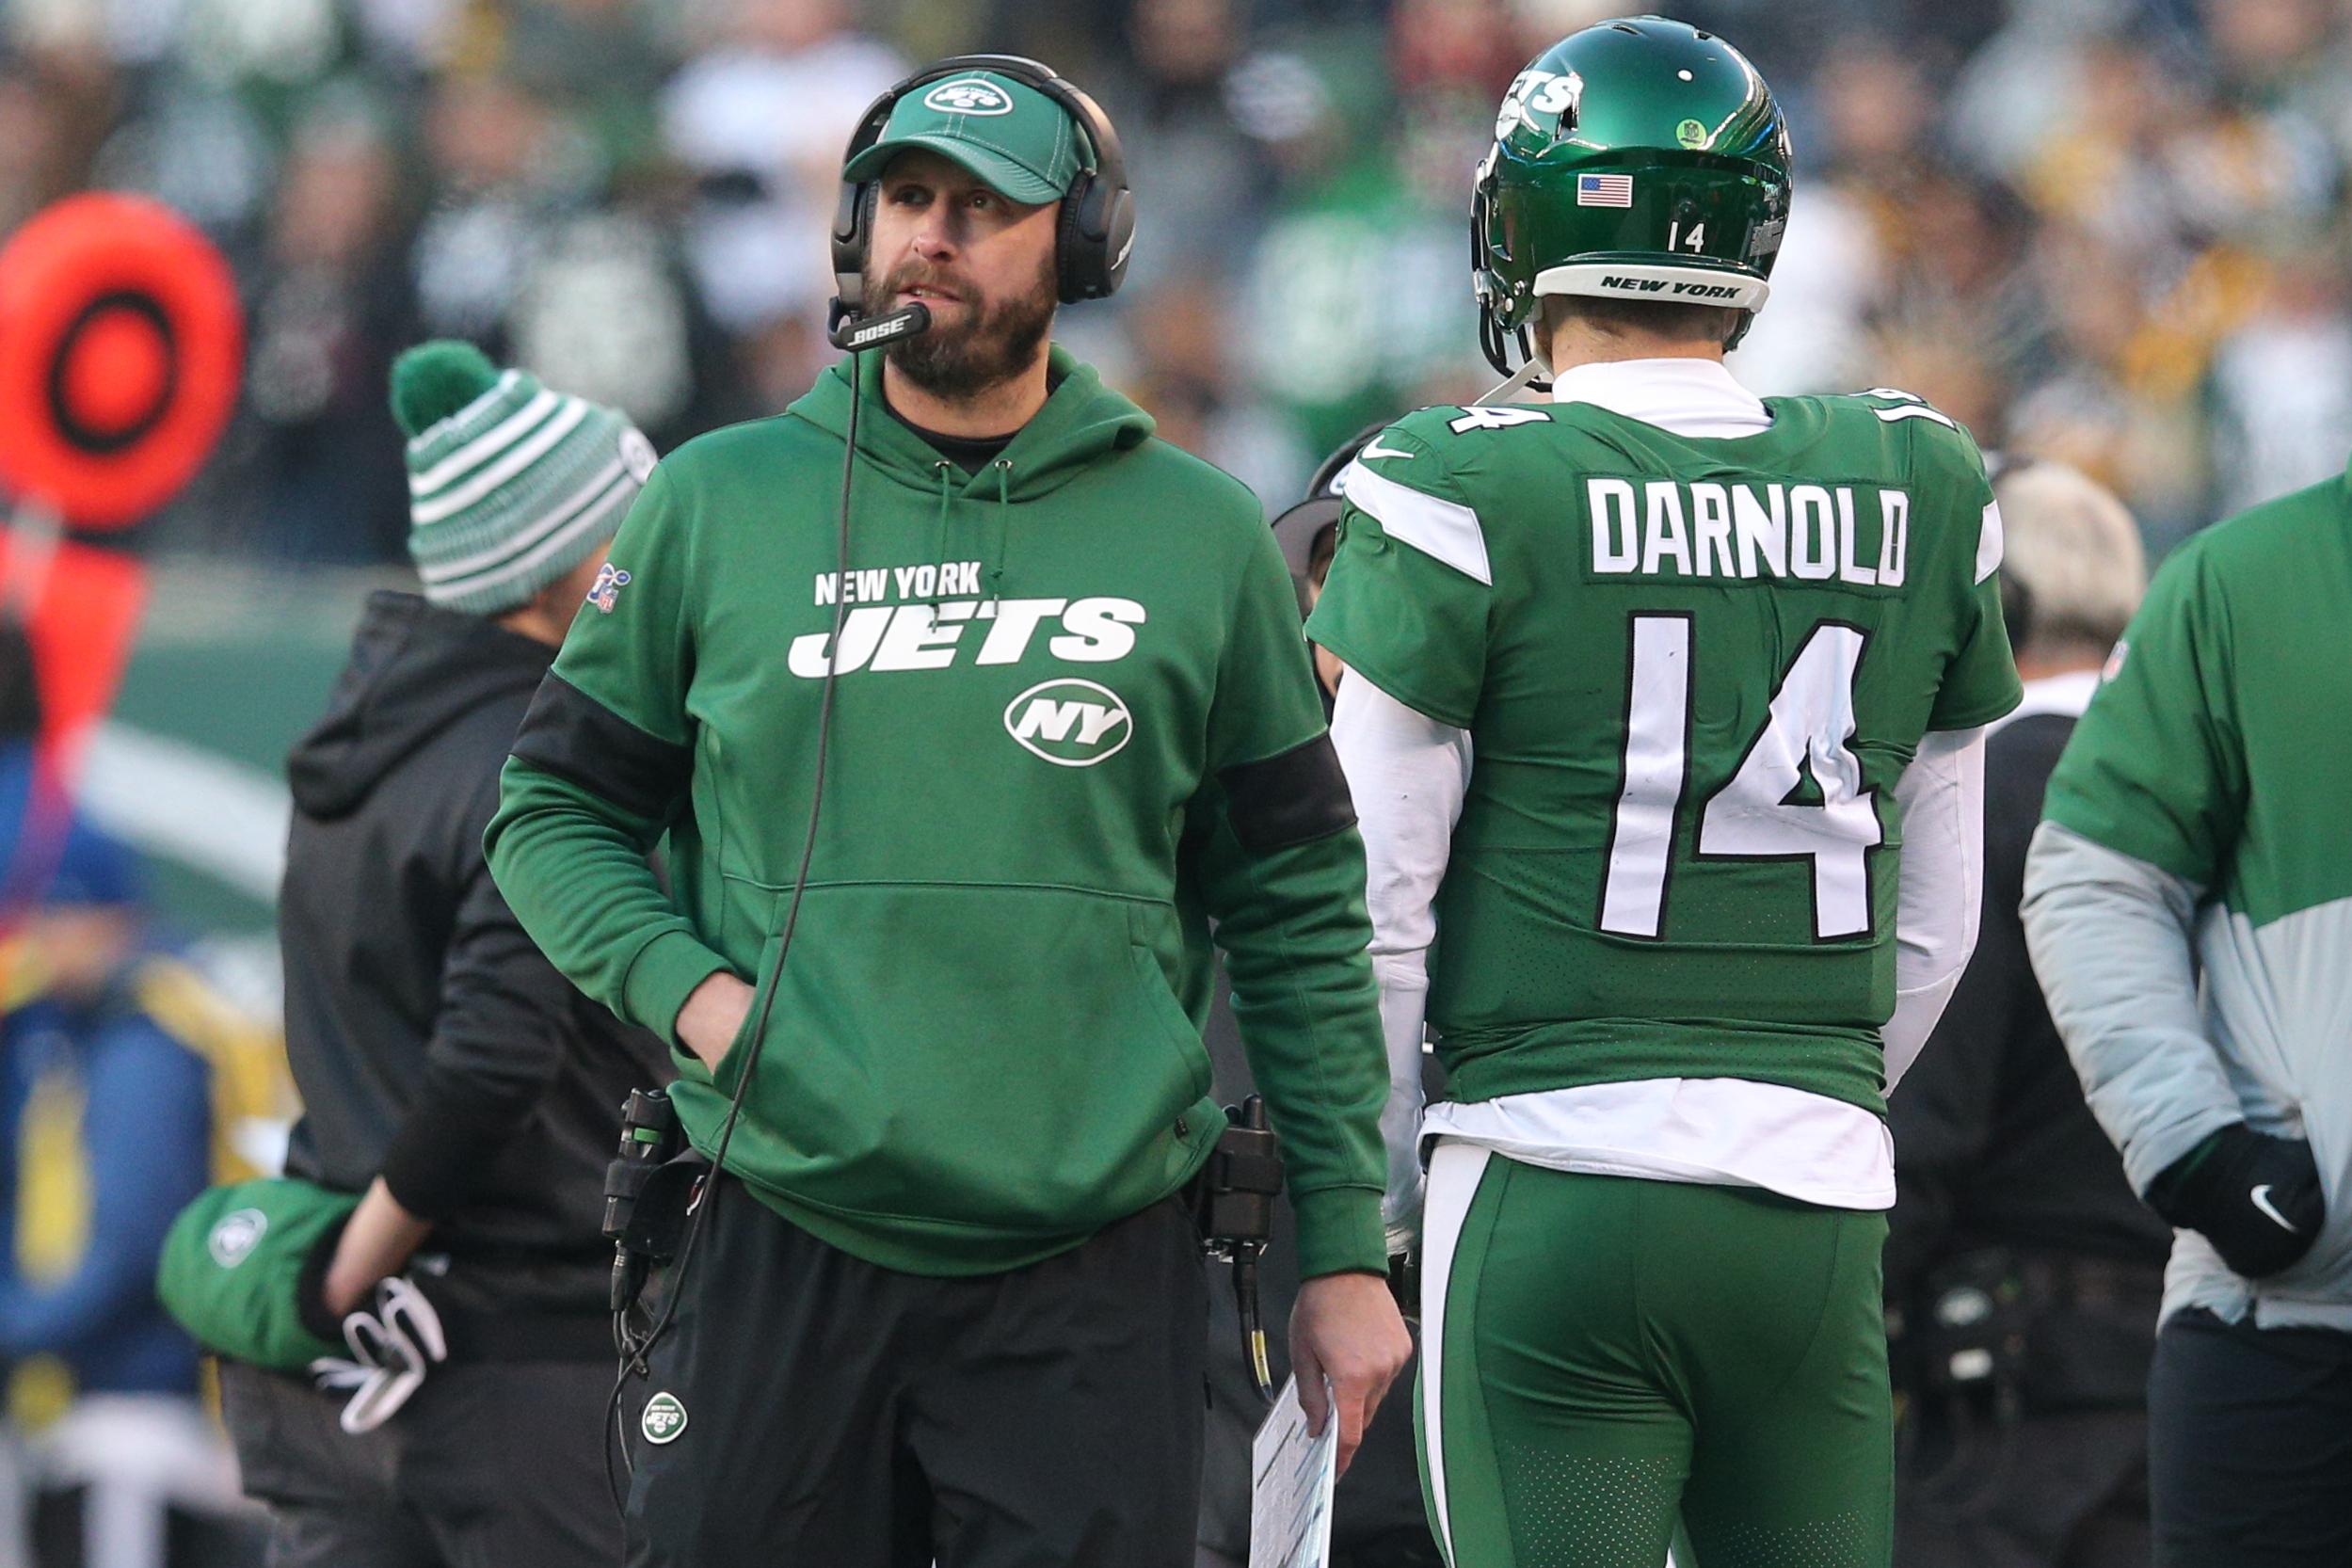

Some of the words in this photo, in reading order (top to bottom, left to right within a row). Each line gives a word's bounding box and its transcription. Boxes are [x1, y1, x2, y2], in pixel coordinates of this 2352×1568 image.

[1668, 221, 1704, 253] 14
[1601, 276, 1669, 293] NEW
[1672, 281, 1742, 299] YORK
[847, 313, 911, 346] BOSE
[1587, 478, 1910, 588] DARNOLD
[814, 568, 888, 606] NEW
[894, 562, 982, 600] YORK
[788, 597, 1147, 679] JETS
[1014, 698, 1128, 744] NY
[1595, 610, 1884, 944] 14
